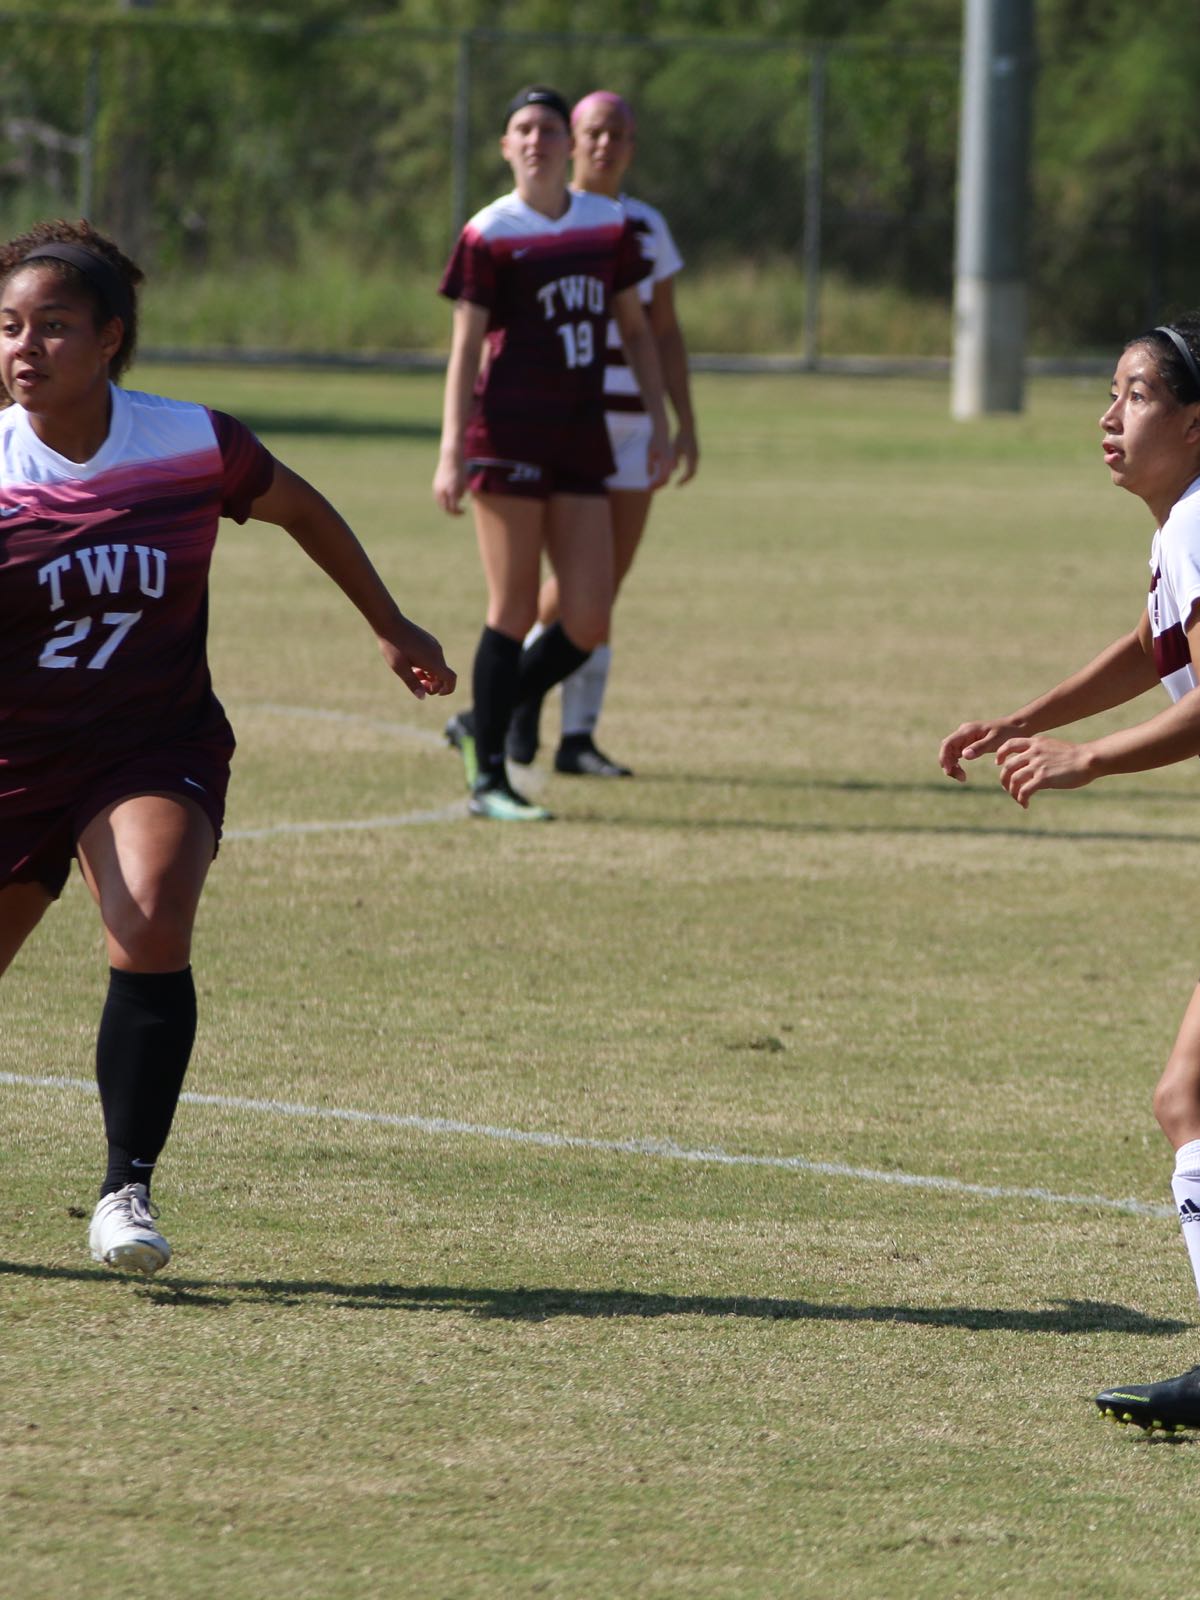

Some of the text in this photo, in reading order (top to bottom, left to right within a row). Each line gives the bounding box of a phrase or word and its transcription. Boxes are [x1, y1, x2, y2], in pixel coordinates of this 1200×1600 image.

[537, 275, 604, 319] TWU
[557, 321, 594, 369] 19
[38, 544, 167, 611] TWU
[38, 609, 143, 670] 27
